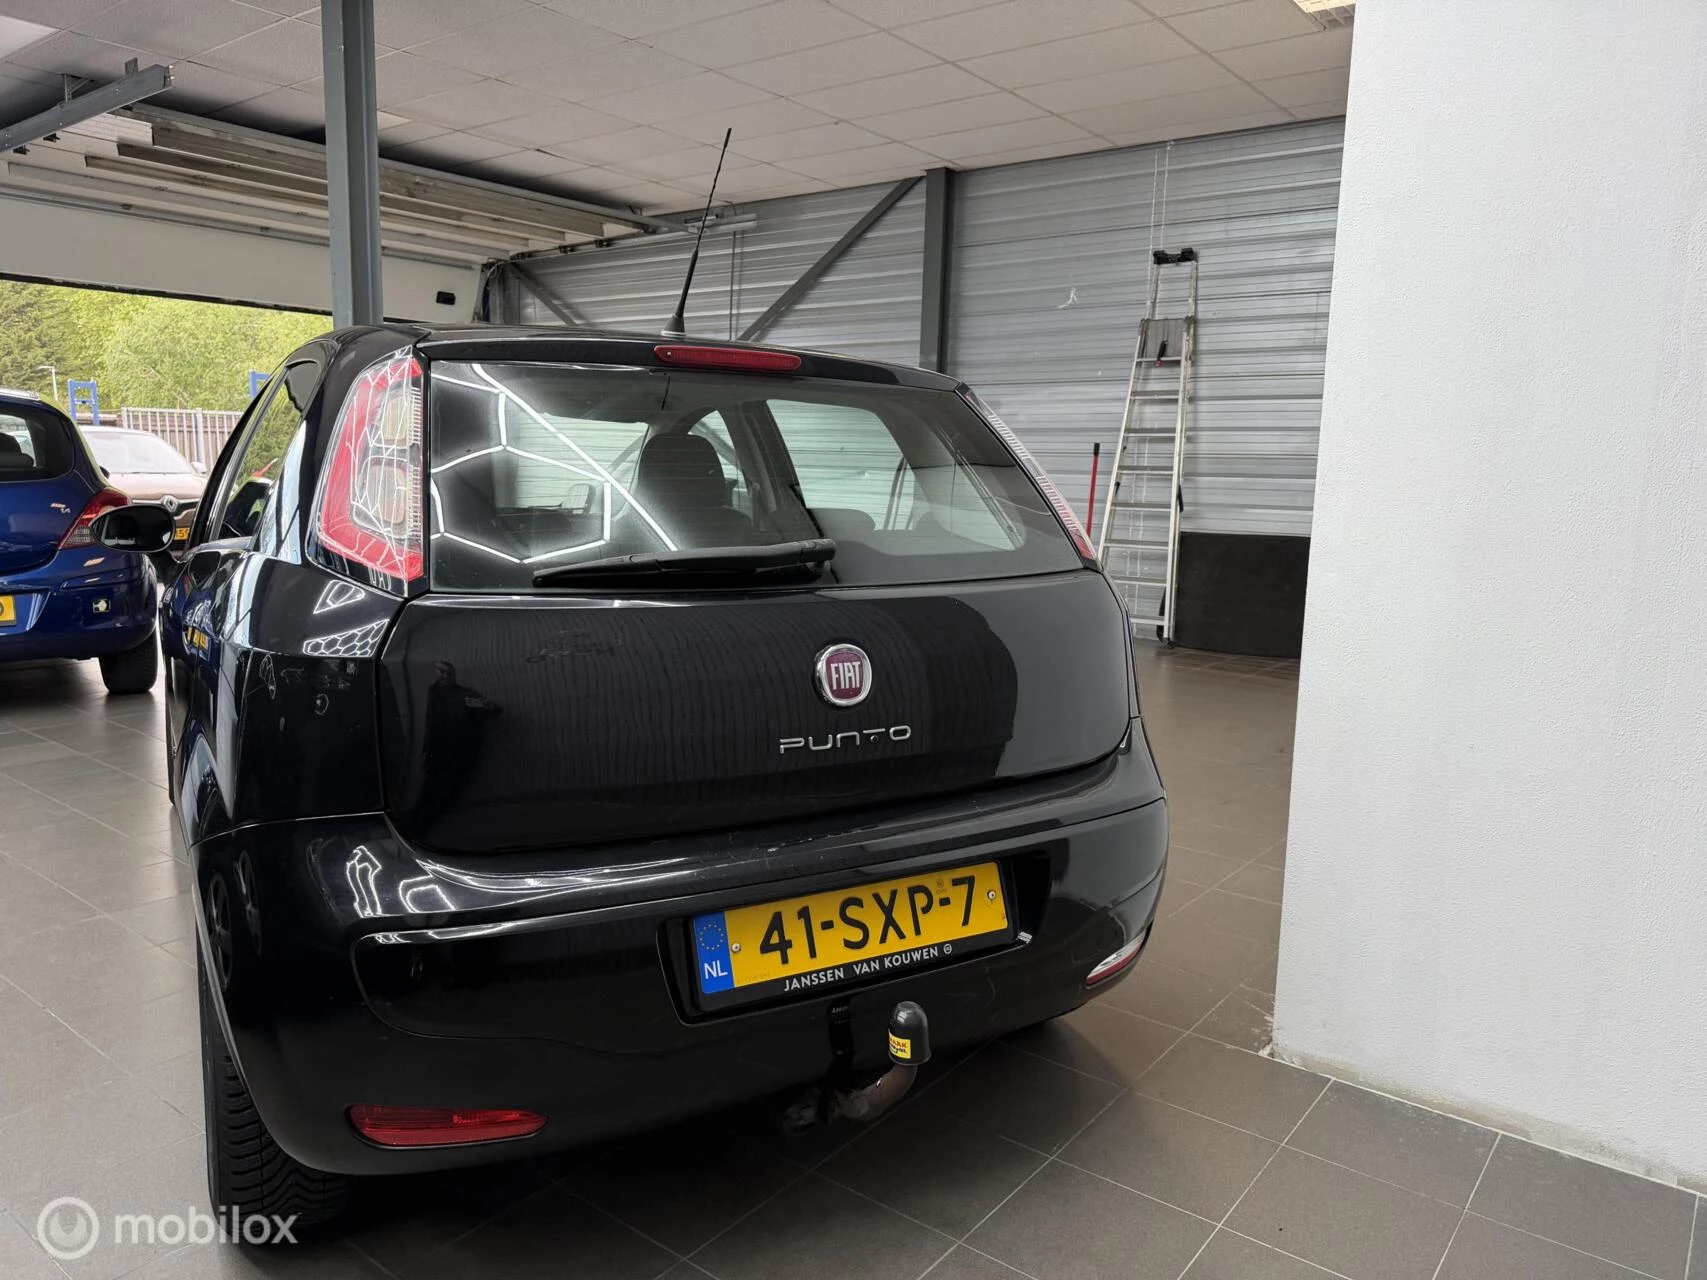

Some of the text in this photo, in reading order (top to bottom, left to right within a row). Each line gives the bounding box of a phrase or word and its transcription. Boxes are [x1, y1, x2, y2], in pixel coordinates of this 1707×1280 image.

[830, 661, 861, 690] FIAT
[780, 725, 912, 754] PUNTO
[759, 874, 976, 966] 41-SXP-7
[703, 959, 729, 980] NL
[784, 967, 845, 993] JANSSEN
[853, 959, 880, 976] VAN
[884, 946, 939, 970] KOUWEN
